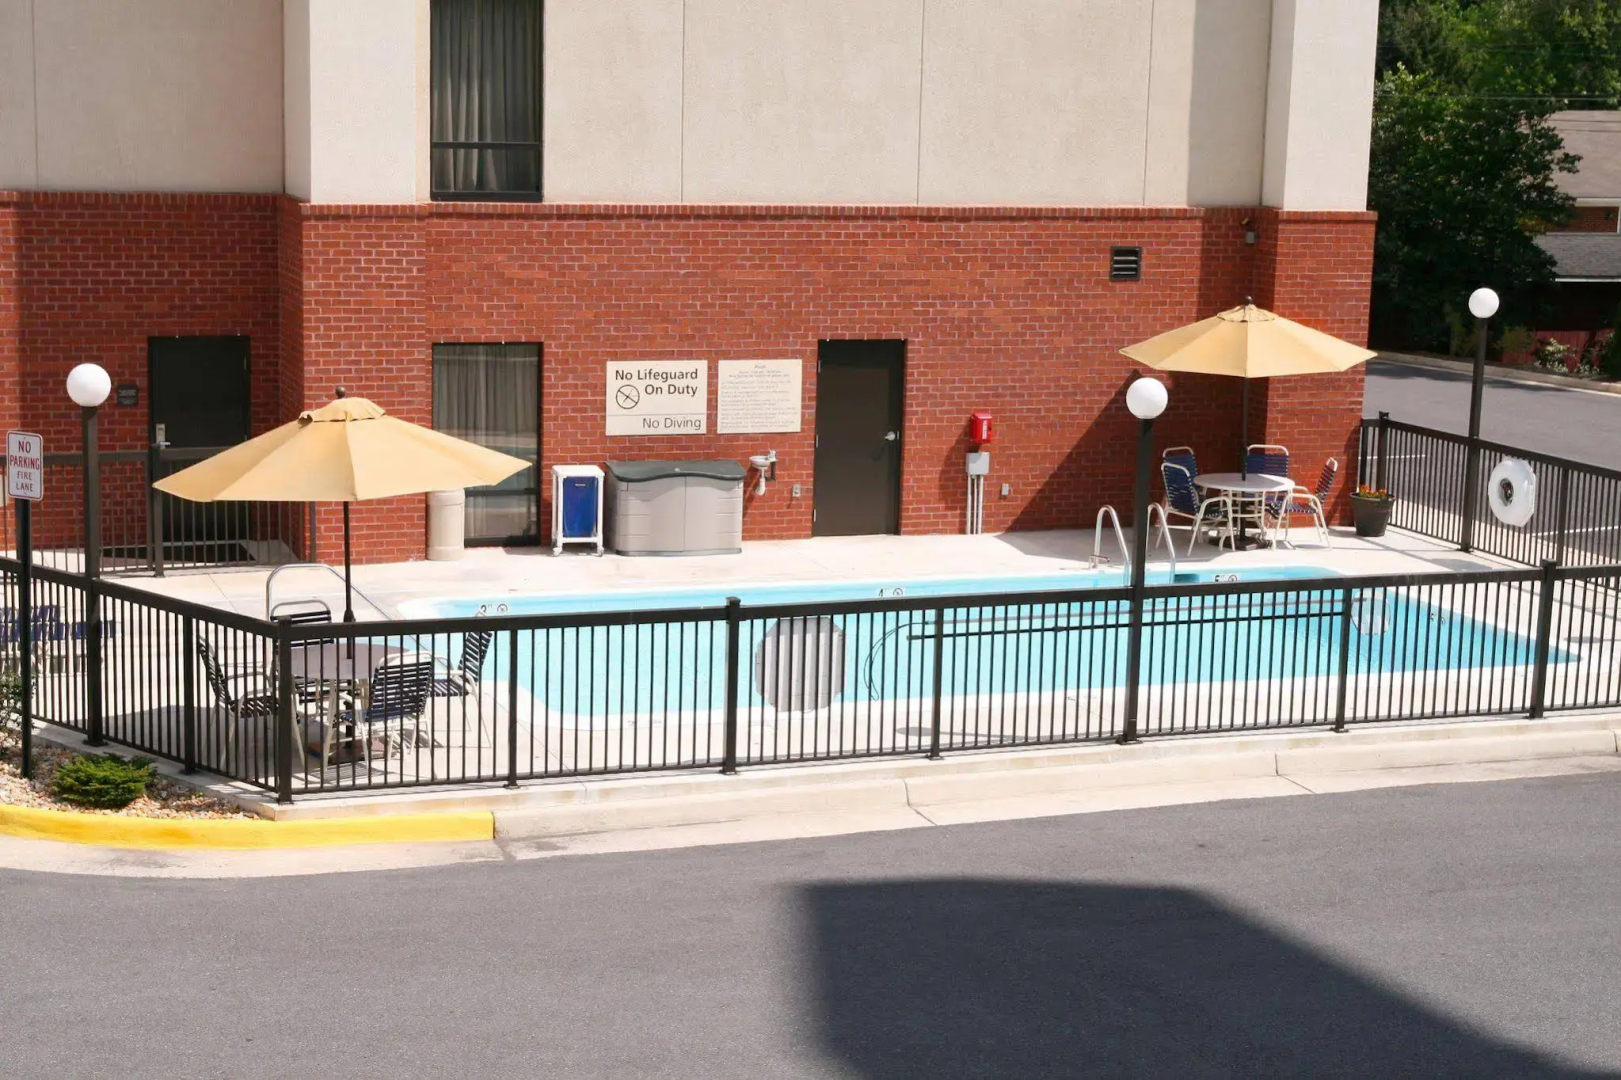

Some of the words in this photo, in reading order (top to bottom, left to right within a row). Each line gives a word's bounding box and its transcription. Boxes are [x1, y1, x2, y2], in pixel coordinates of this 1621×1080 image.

[615, 369, 633, 381] No
[637, 368, 699, 383] Lifeguard
[644, 384, 663, 396] On
[667, 384, 698, 398] Duty
[642, 418, 660, 429] No
[664, 417, 702, 431] Diving
[18, 440, 31, 453] NO
[10, 455, 40, 470] PARKING
[17, 471, 32, 480] FIRE
[16, 482, 33, 491] LANE
